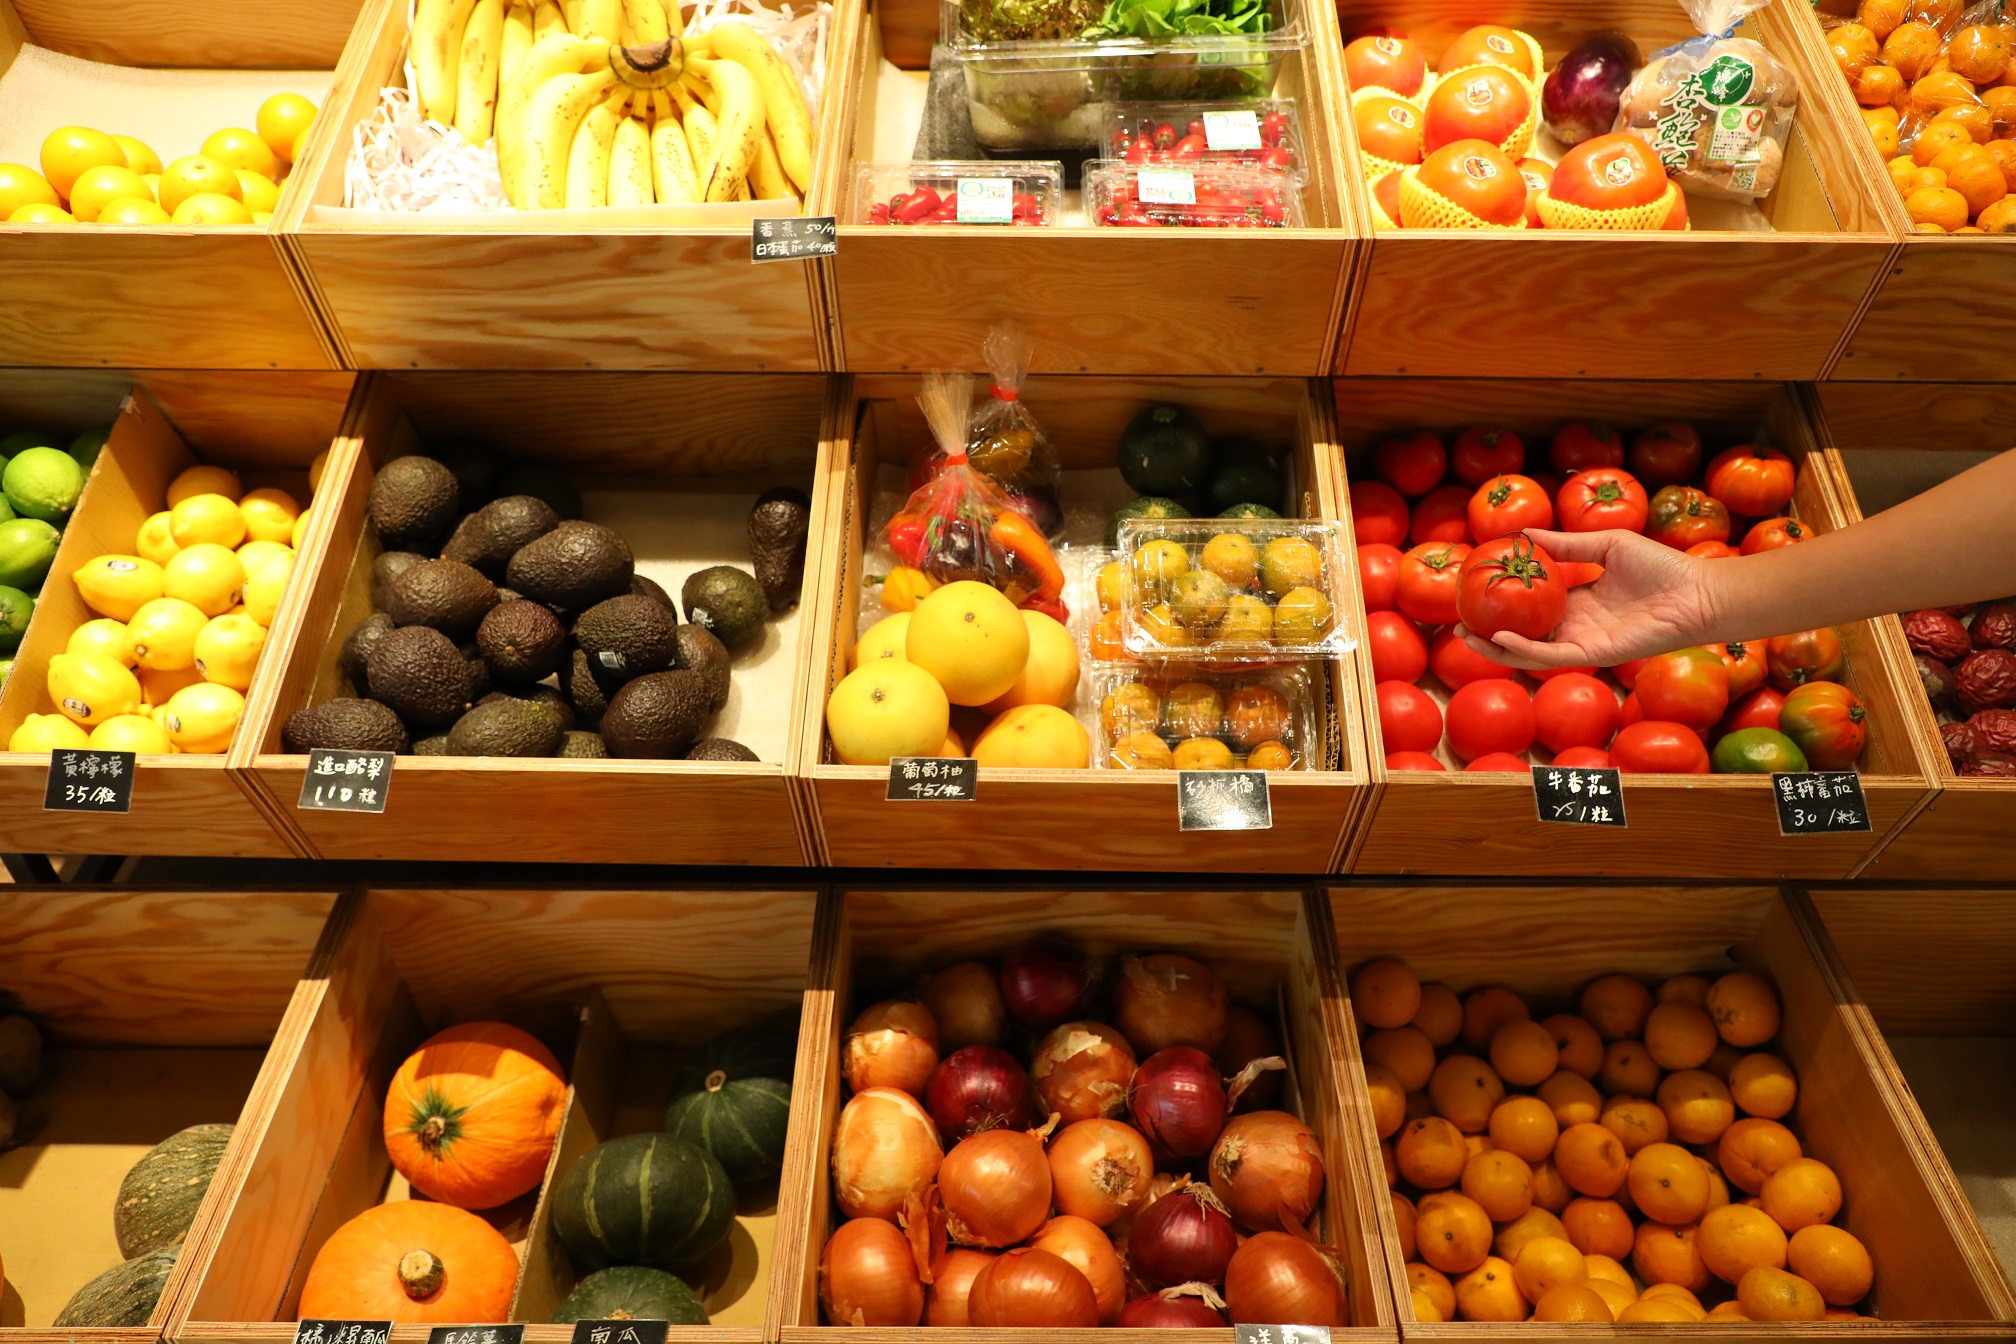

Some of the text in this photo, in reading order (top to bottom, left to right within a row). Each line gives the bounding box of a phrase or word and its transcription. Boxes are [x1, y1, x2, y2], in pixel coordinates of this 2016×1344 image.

[313, 755, 385, 781] 進口酪梨
[902, 761, 964, 780] 葡萄柚
[65, 784, 117, 805] 35/粒
[1548, 771, 1612, 798] 牛番茄
[590, 1325, 641, 1344] 南瓜
